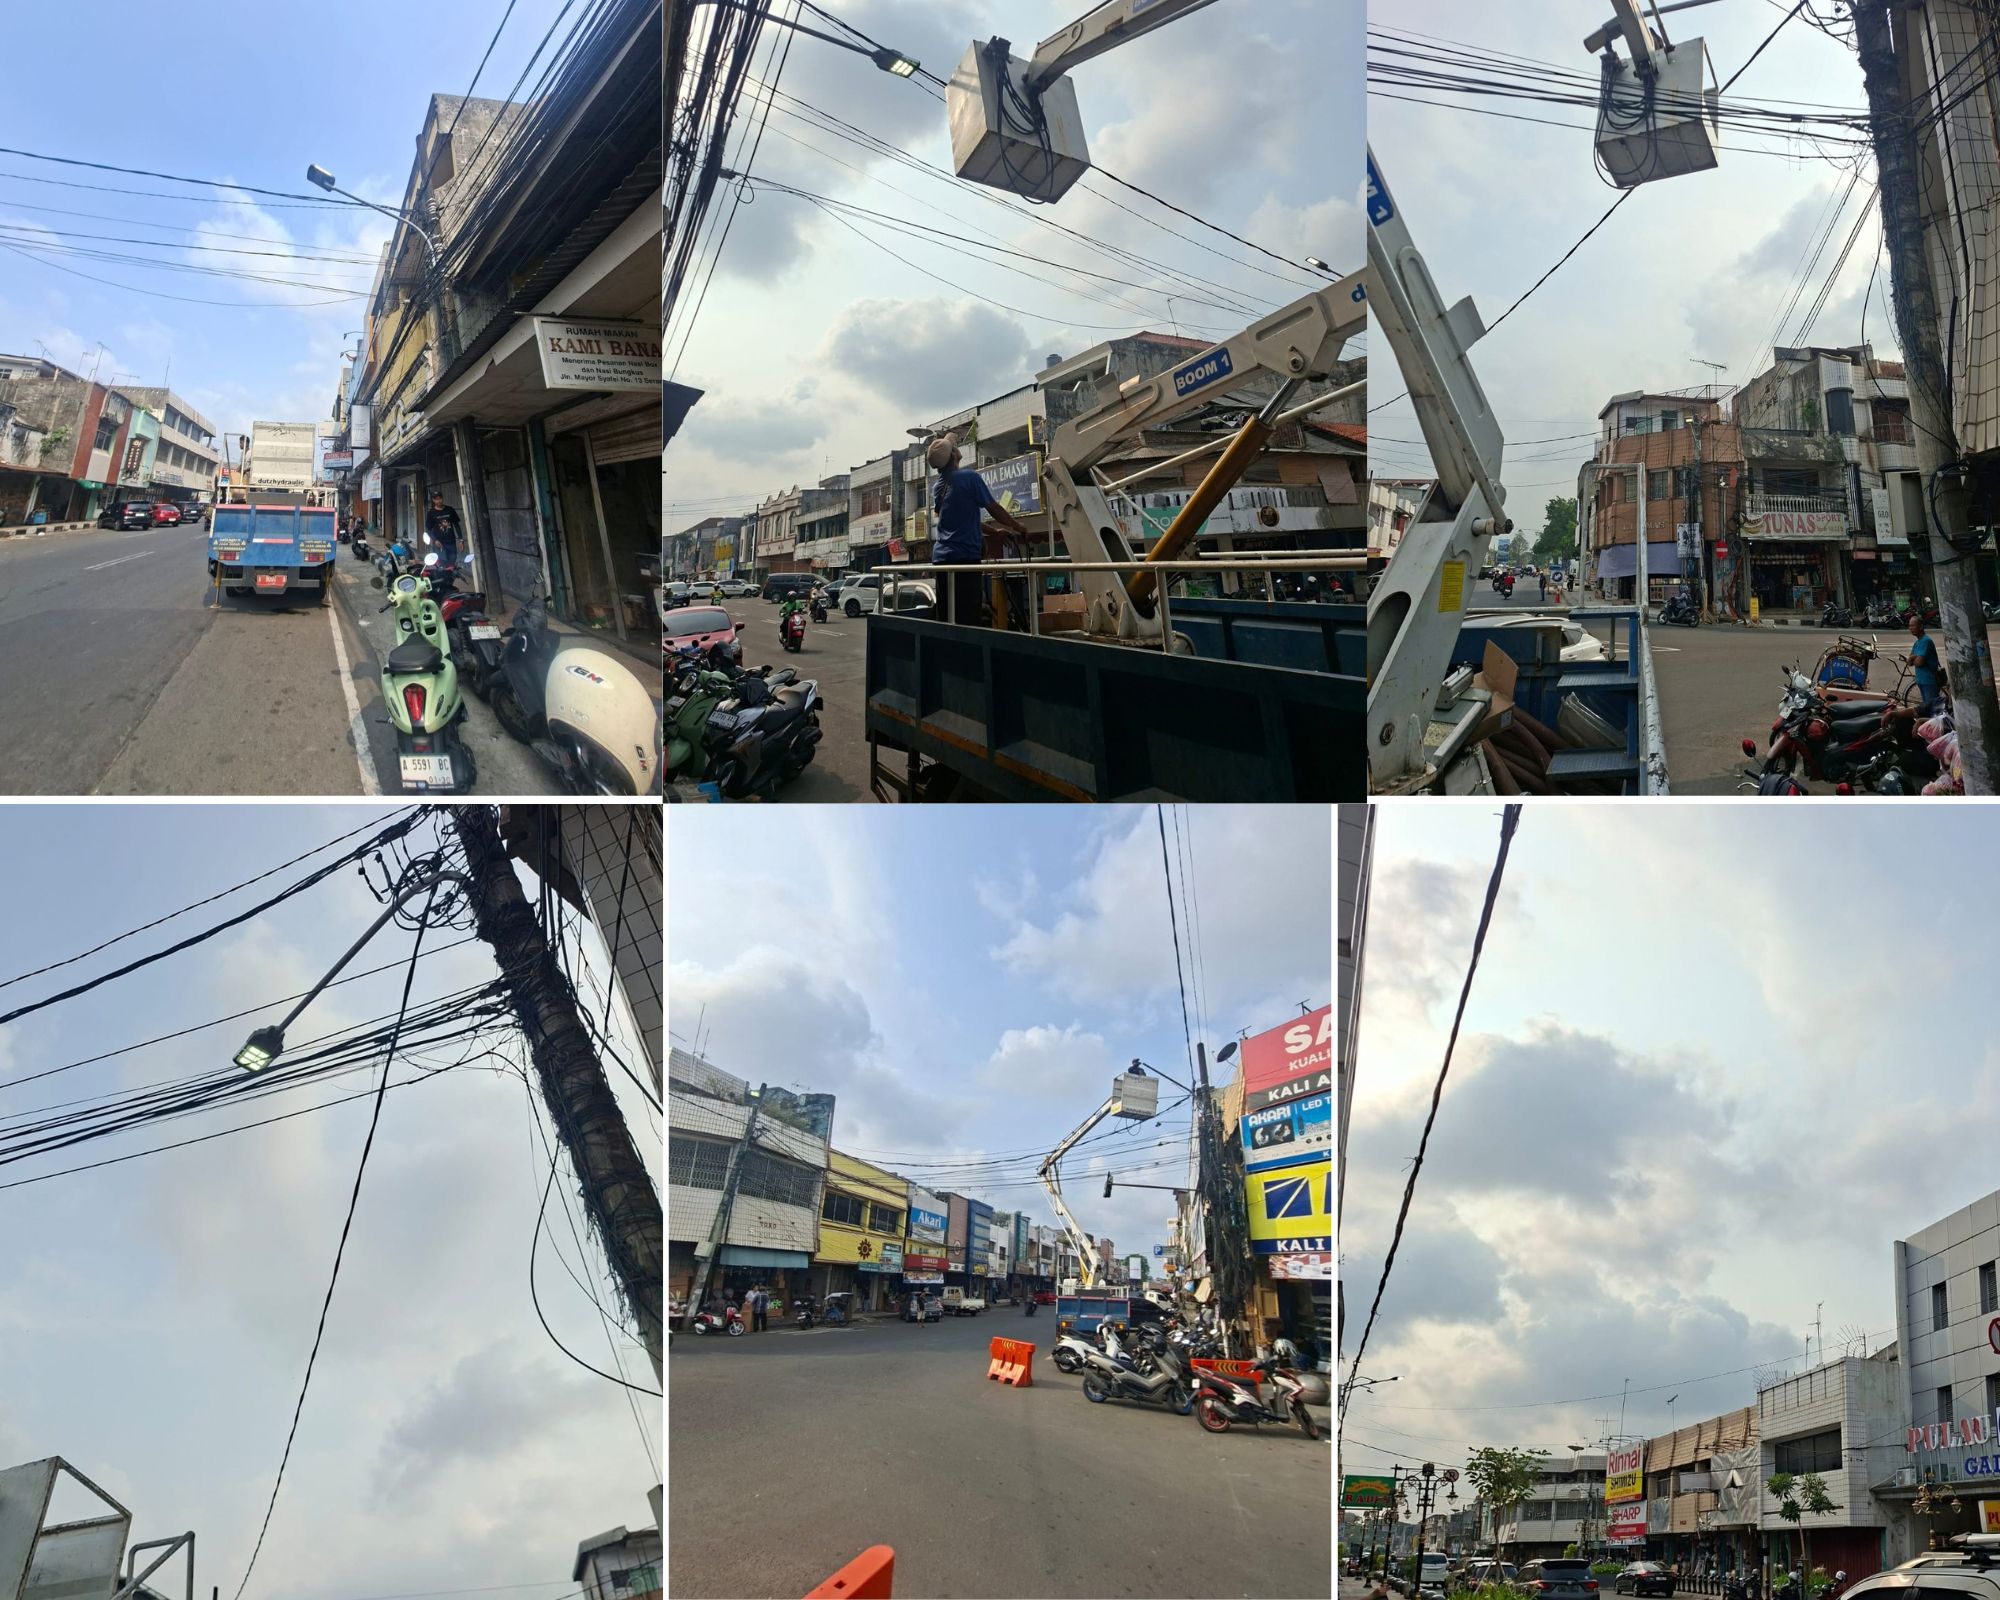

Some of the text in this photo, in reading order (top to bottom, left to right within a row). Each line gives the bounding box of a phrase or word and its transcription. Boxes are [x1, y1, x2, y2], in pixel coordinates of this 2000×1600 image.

[1376, 205, 1388, 220] 1
[566, 327, 638, 338] RUMAH MAKAN
[548, 337, 604, 355] KAMI
[562, 357, 596, 365] Menerima
[574, 374, 596, 382] Mayor
[614, 368, 644, 376] Bungkus
[1175, 355, 1230, 390] BOOM 1
[1763, 513, 1816, 534] TUNAS
[1816, 514, 1841, 522] SPORT
[574, 667, 604, 684] GM
[402, 758, 450, 770] A 5591 BC
[636, 746, 648, 772] GM
[1268, 1074, 1331, 1102] KALI A
[1248, 1105, 1292, 1127] AKARI
[1302, 1097, 1322, 1111] LED
[918, 1210, 942, 1228] Akari
[1276, 1238, 1325, 1252] KALI
[1908, 1414, 1991, 1454] PULAU
[1608, 1443, 1640, 1475] Rinnai
[1612, 1506, 1640, 1522] SHARP
